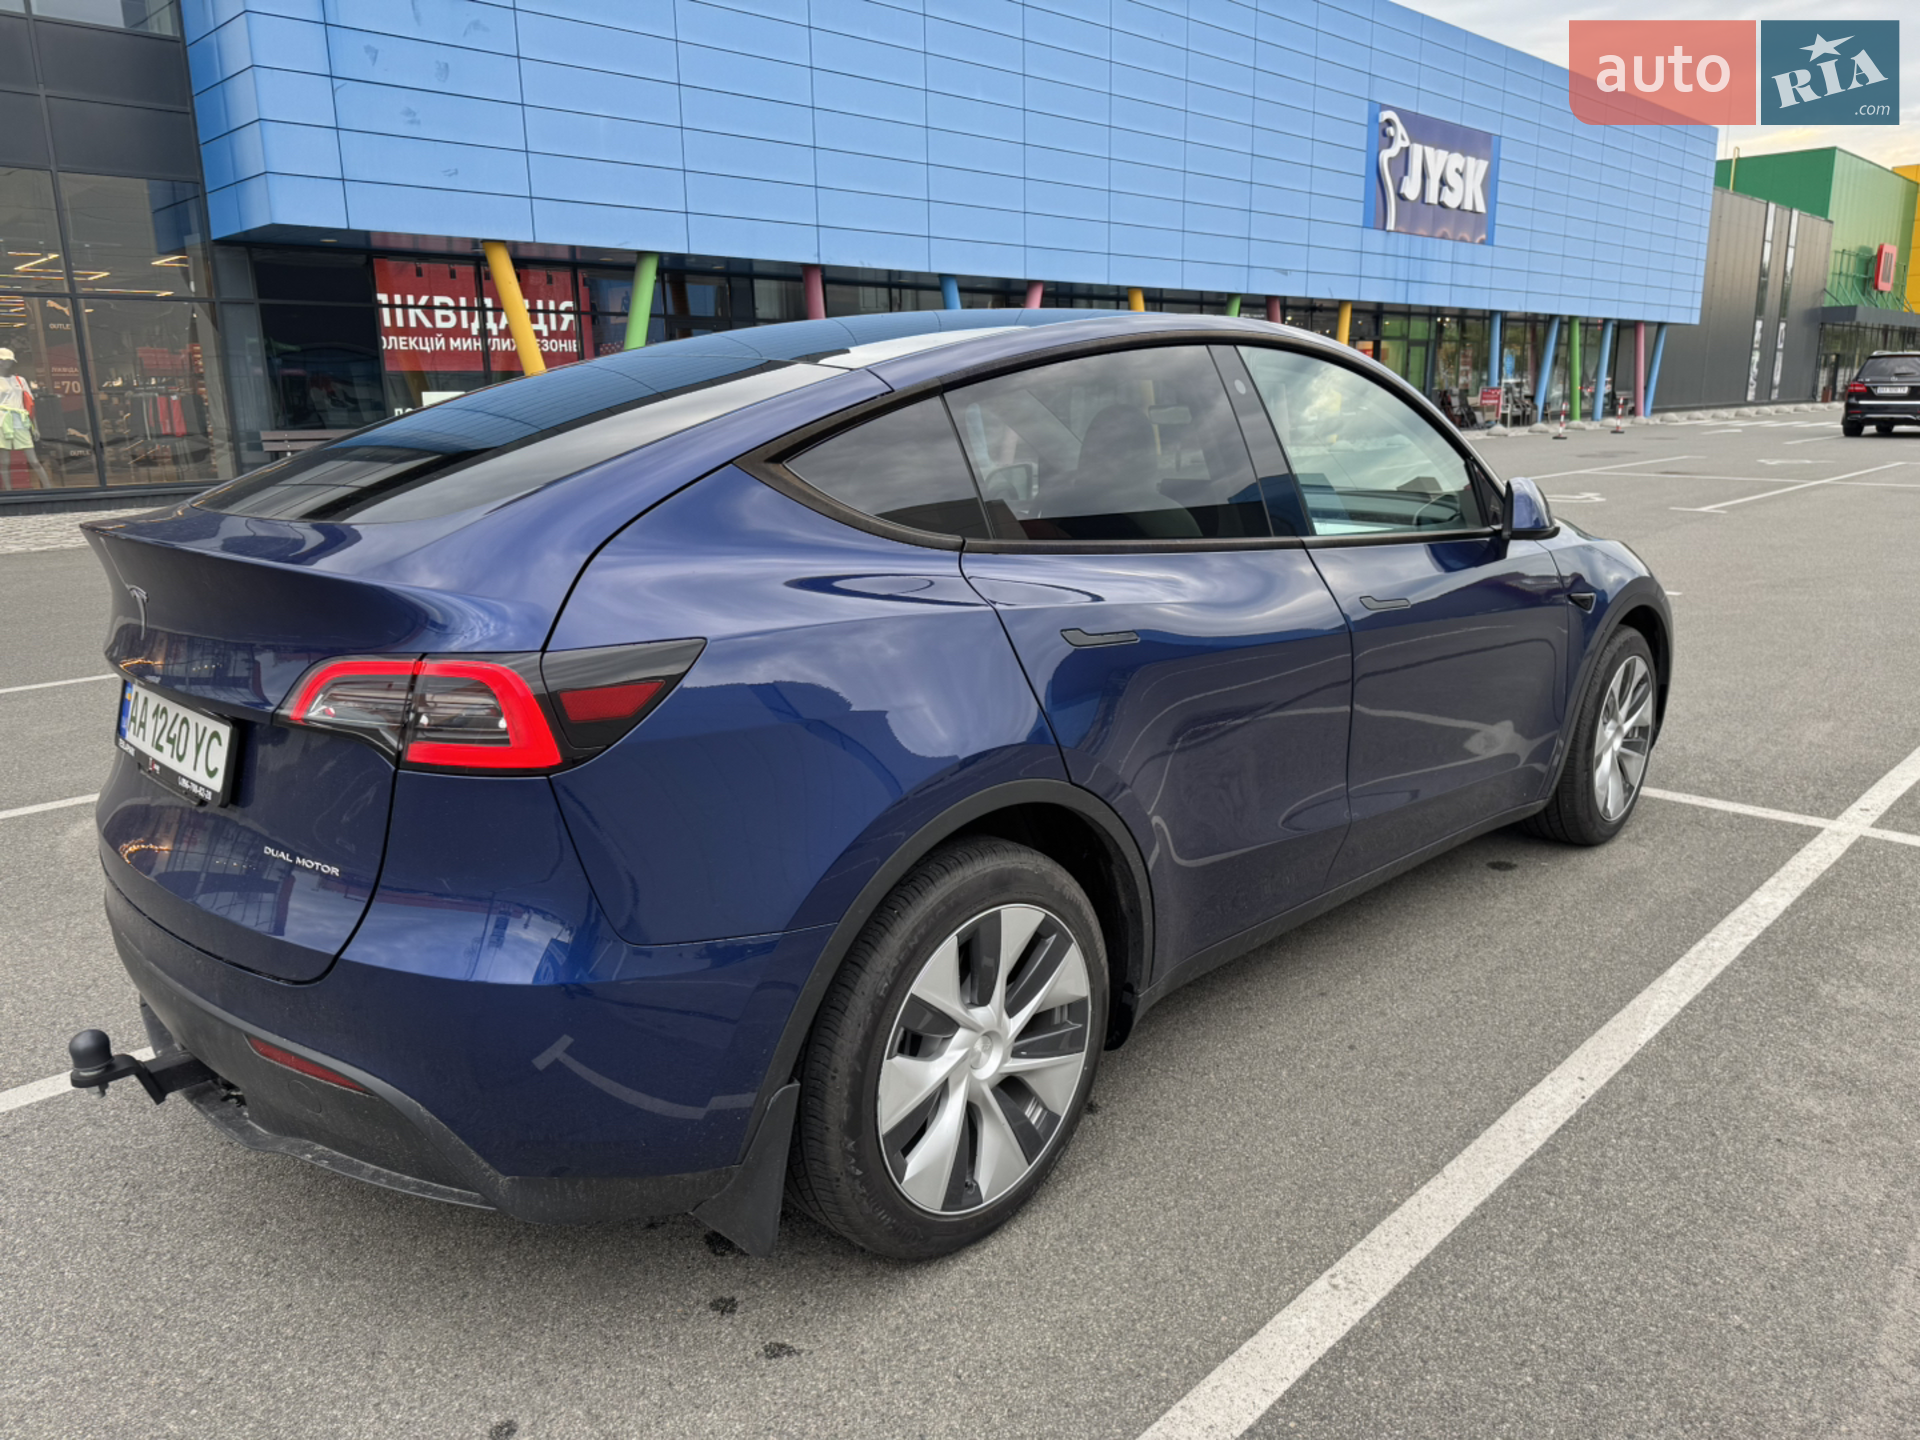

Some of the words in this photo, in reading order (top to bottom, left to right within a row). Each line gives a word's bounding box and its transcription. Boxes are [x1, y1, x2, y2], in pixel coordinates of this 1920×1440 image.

[1400, 143, 1489, 214] JYSK
[128, 691, 149, 743] AA
[151, 703, 190, 764] 1240
[193, 721, 223, 779] YC
[263, 845, 293, 863] DUAL
[295, 855, 340, 877] MOTOR
